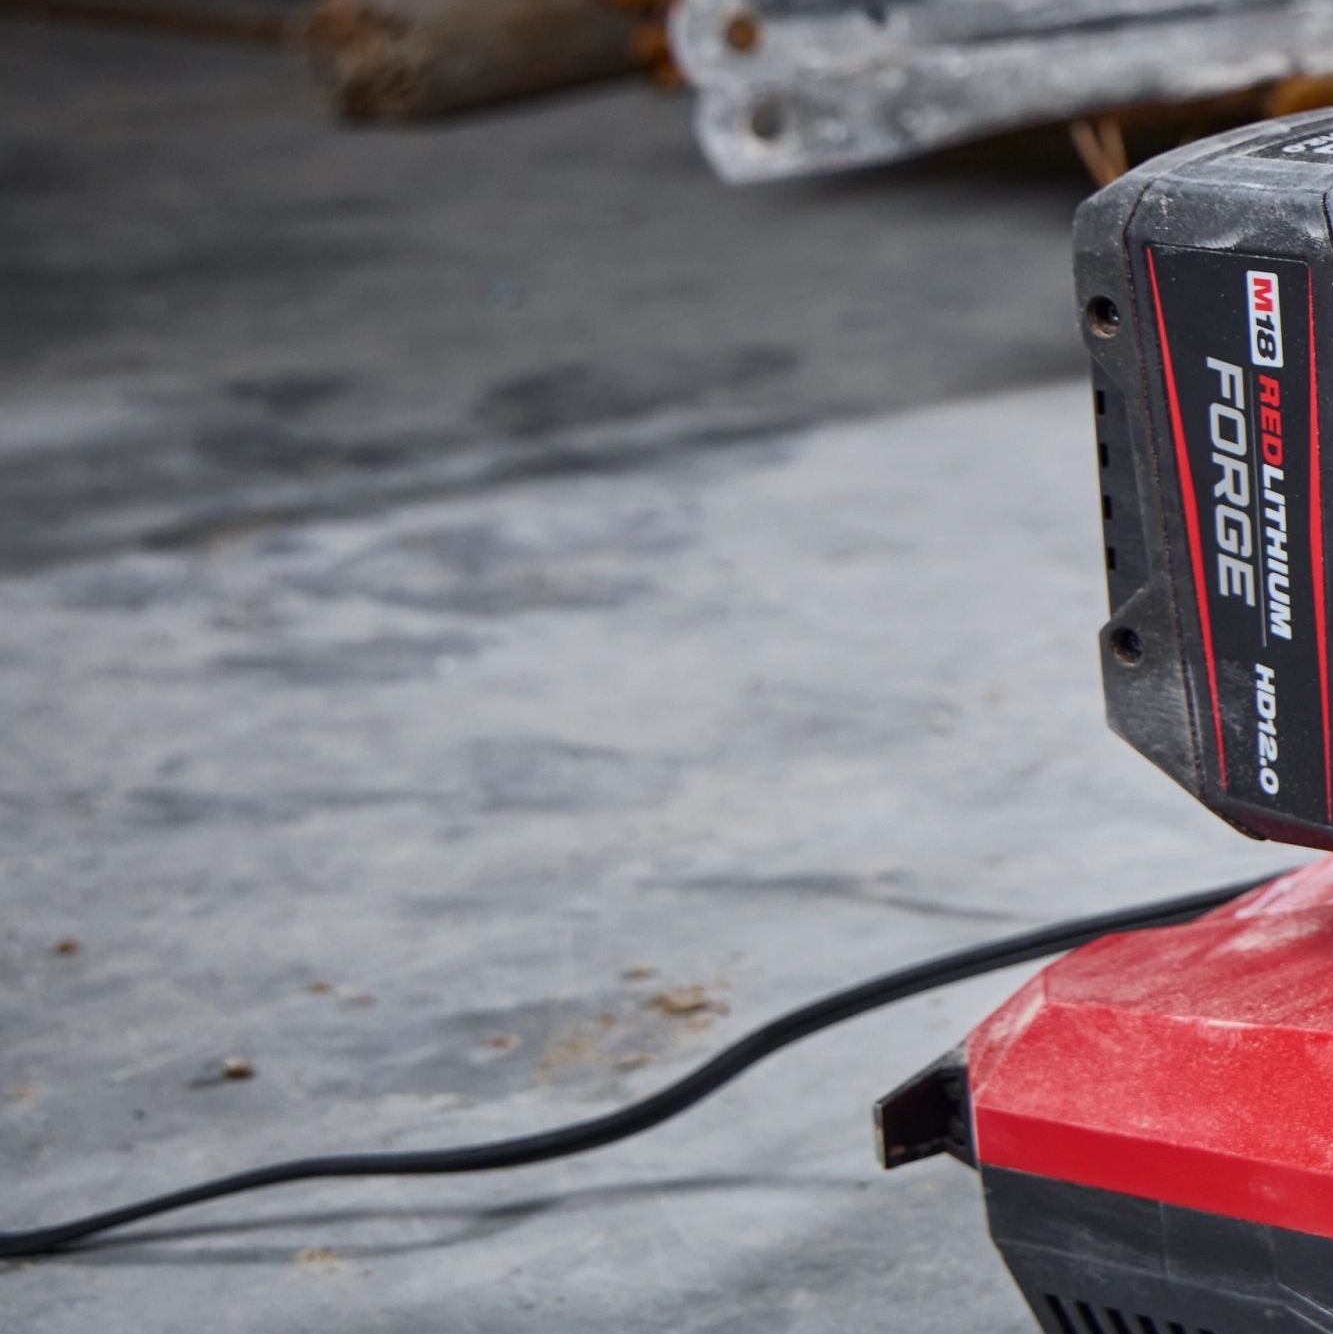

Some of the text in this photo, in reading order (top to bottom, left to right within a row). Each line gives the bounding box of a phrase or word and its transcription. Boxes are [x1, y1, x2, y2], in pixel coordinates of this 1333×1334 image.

[1206, 356, 1255, 607] FORGE
[1253, 277, 1292, 640] M18 REDLITHIUM
[1255, 663, 1279, 795] HD12.0
